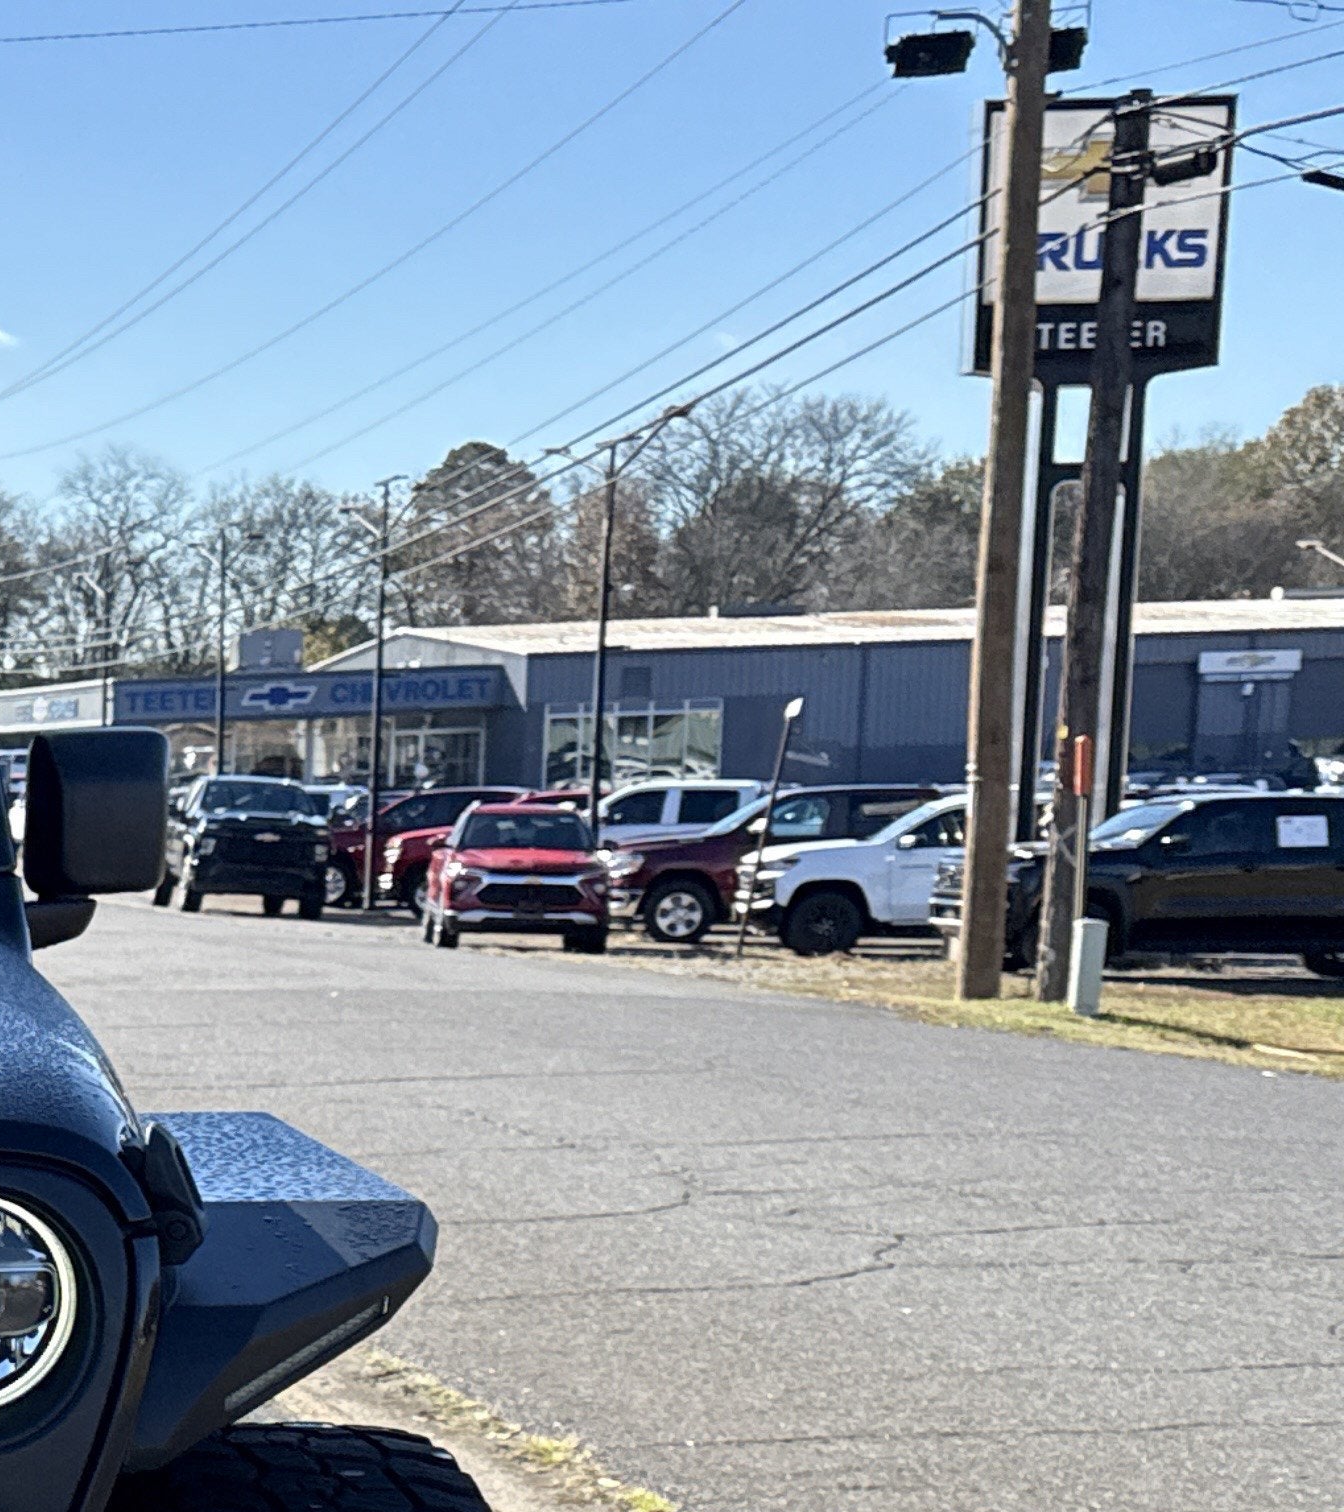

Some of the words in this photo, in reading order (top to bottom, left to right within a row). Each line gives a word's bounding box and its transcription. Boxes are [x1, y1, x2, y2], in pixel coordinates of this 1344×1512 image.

[1035, 229, 1209, 271] RUKS
[1036, 319, 1167, 350] TEEER
[329, 678, 491, 704] CHVROLET
